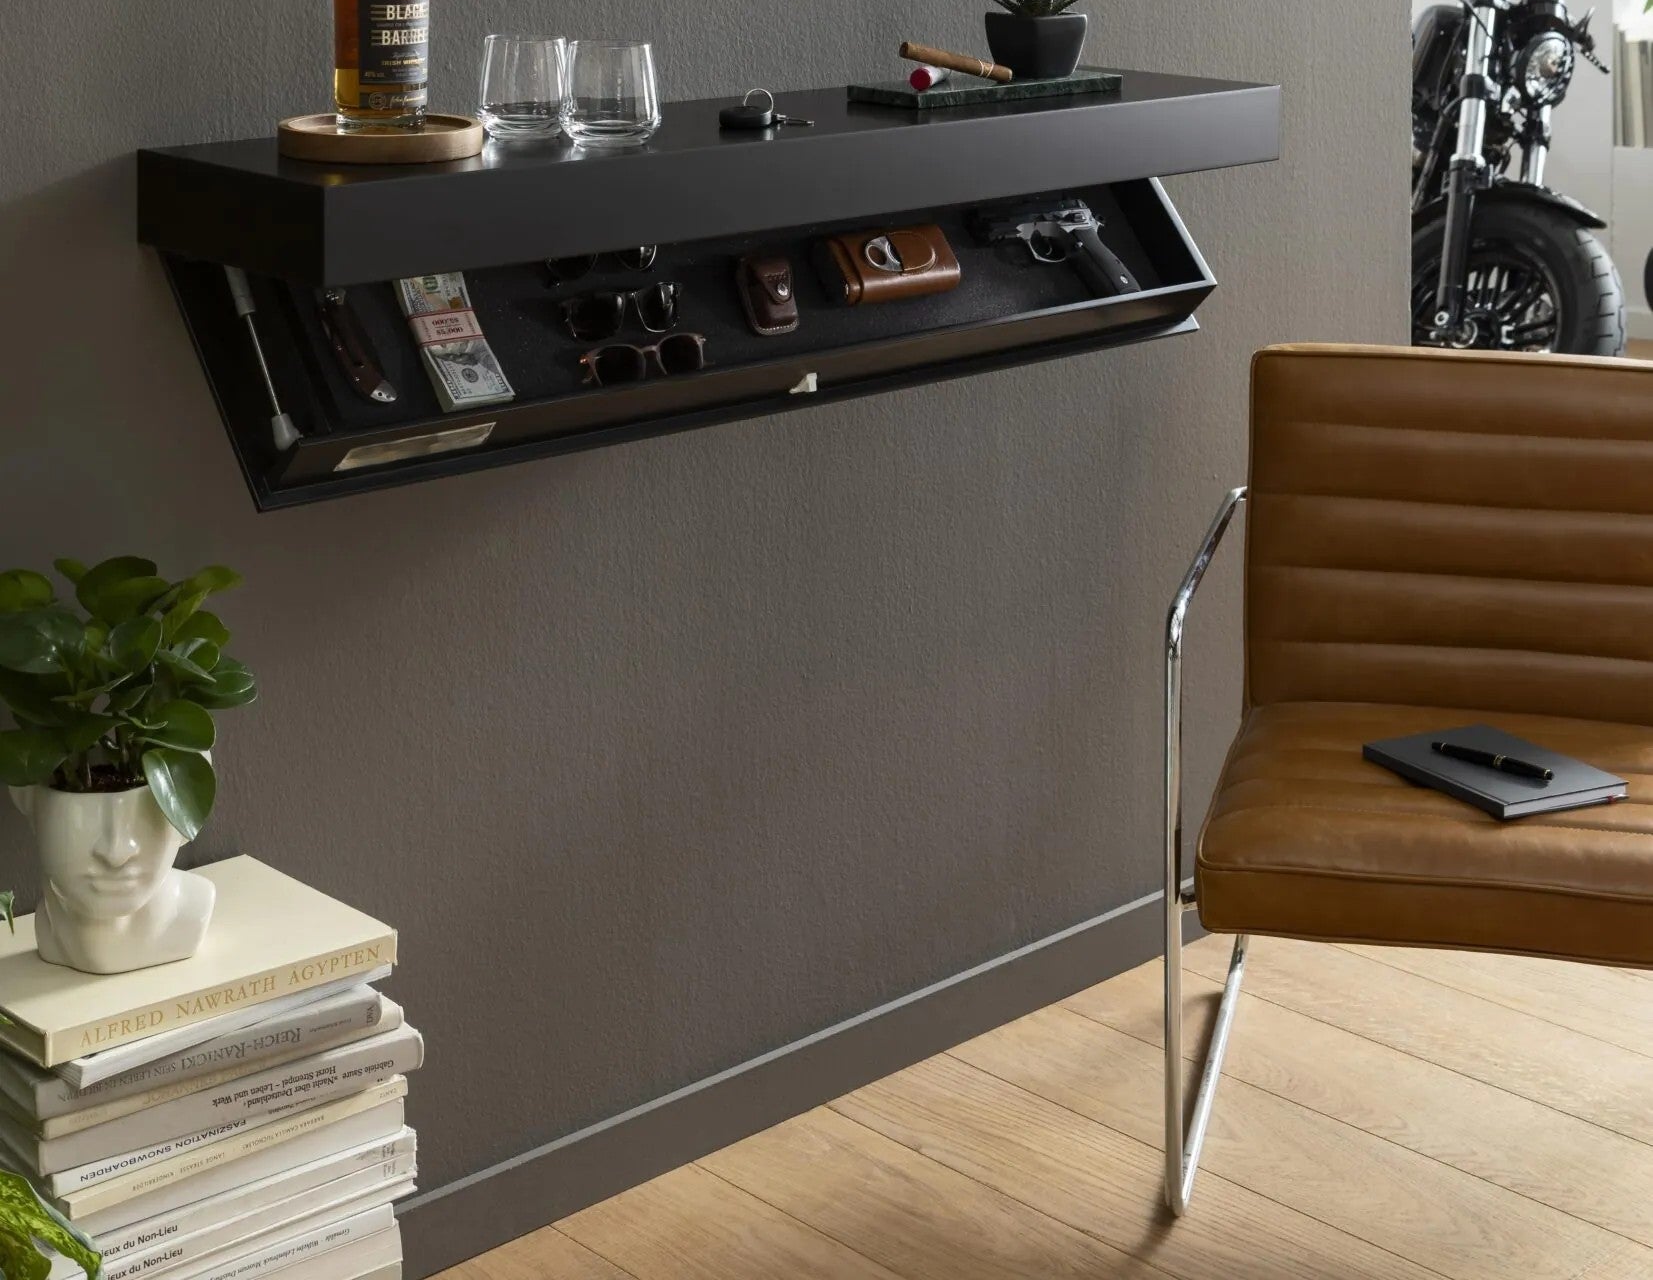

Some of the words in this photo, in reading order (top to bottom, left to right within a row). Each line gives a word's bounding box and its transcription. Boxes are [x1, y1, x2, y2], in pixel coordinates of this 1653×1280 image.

[386, 4, 427, 20] BLACK
[80, 1009, 164, 1048] ALFRED
[176, 976, 276, 1019] NAWRATH
[181, 1026, 302, 1070] REICH-RANICKI
[153, 1062, 177, 1077] SEIN
[315, 1065, 336, 1079] Horst
[363, 1059, 394, 1074] Gabriele
[119, 1070, 151, 1086] LEBEN
[281, 1071, 314, 1088] Strempel
[341, 1069, 363, 1080] Saure
[233, 1089, 248, 1102] und
[250, 1083, 273, 1096] Leben
[293, 1083, 311, 1095] über
[212, 1095, 232, 1107] Werk
[175, 1119, 247, 1149] FASZINATION
[80, 1144, 171, 1182] SNOWBOARDEN
[205, 1152, 225, 1164] LANGE
[179, 1158, 204, 1174] STRASSE
[101, 1246, 121, 1257] ieux
[123, 1240, 135, 1250] du
[137, 1224, 178, 1245] Non-Lieu
[129, 1263, 141, 1274] du
[143, 1247, 183, 1269] Non-Lieu
[237, 1259, 261, 1273] Museum
